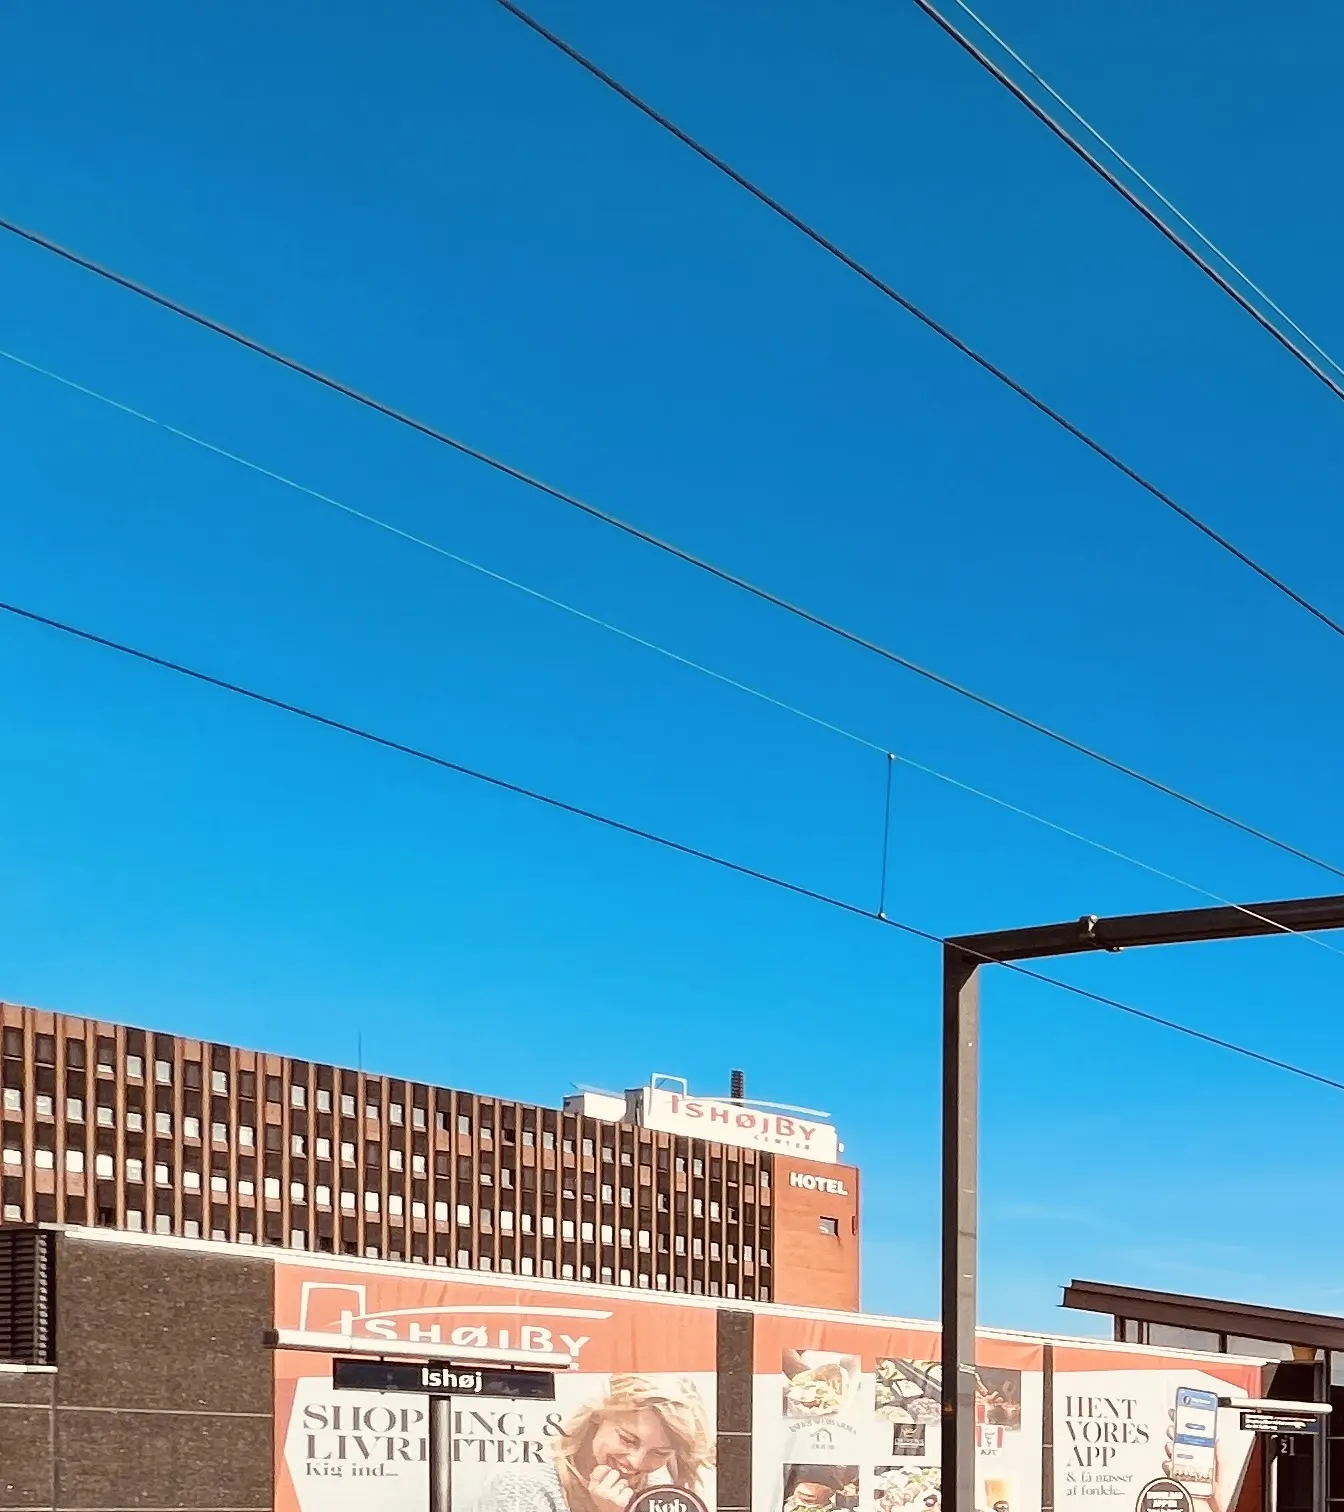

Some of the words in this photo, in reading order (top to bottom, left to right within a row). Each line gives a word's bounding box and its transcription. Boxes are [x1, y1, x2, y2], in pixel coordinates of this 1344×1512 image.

[789, 1171, 849, 1196] HOTEL
[422, 1367, 482, 1393] Ishøj
[1066, 1396, 1137, 1419] HENT
[303, 1404, 526, 1436] SHOPING
[542, 1412, 571, 1437] &
[1066, 1421, 1150, 1444] VORES
[1066, 1446, 1116, 1467] APP
[306, 1462, 343, 1477] Kig
